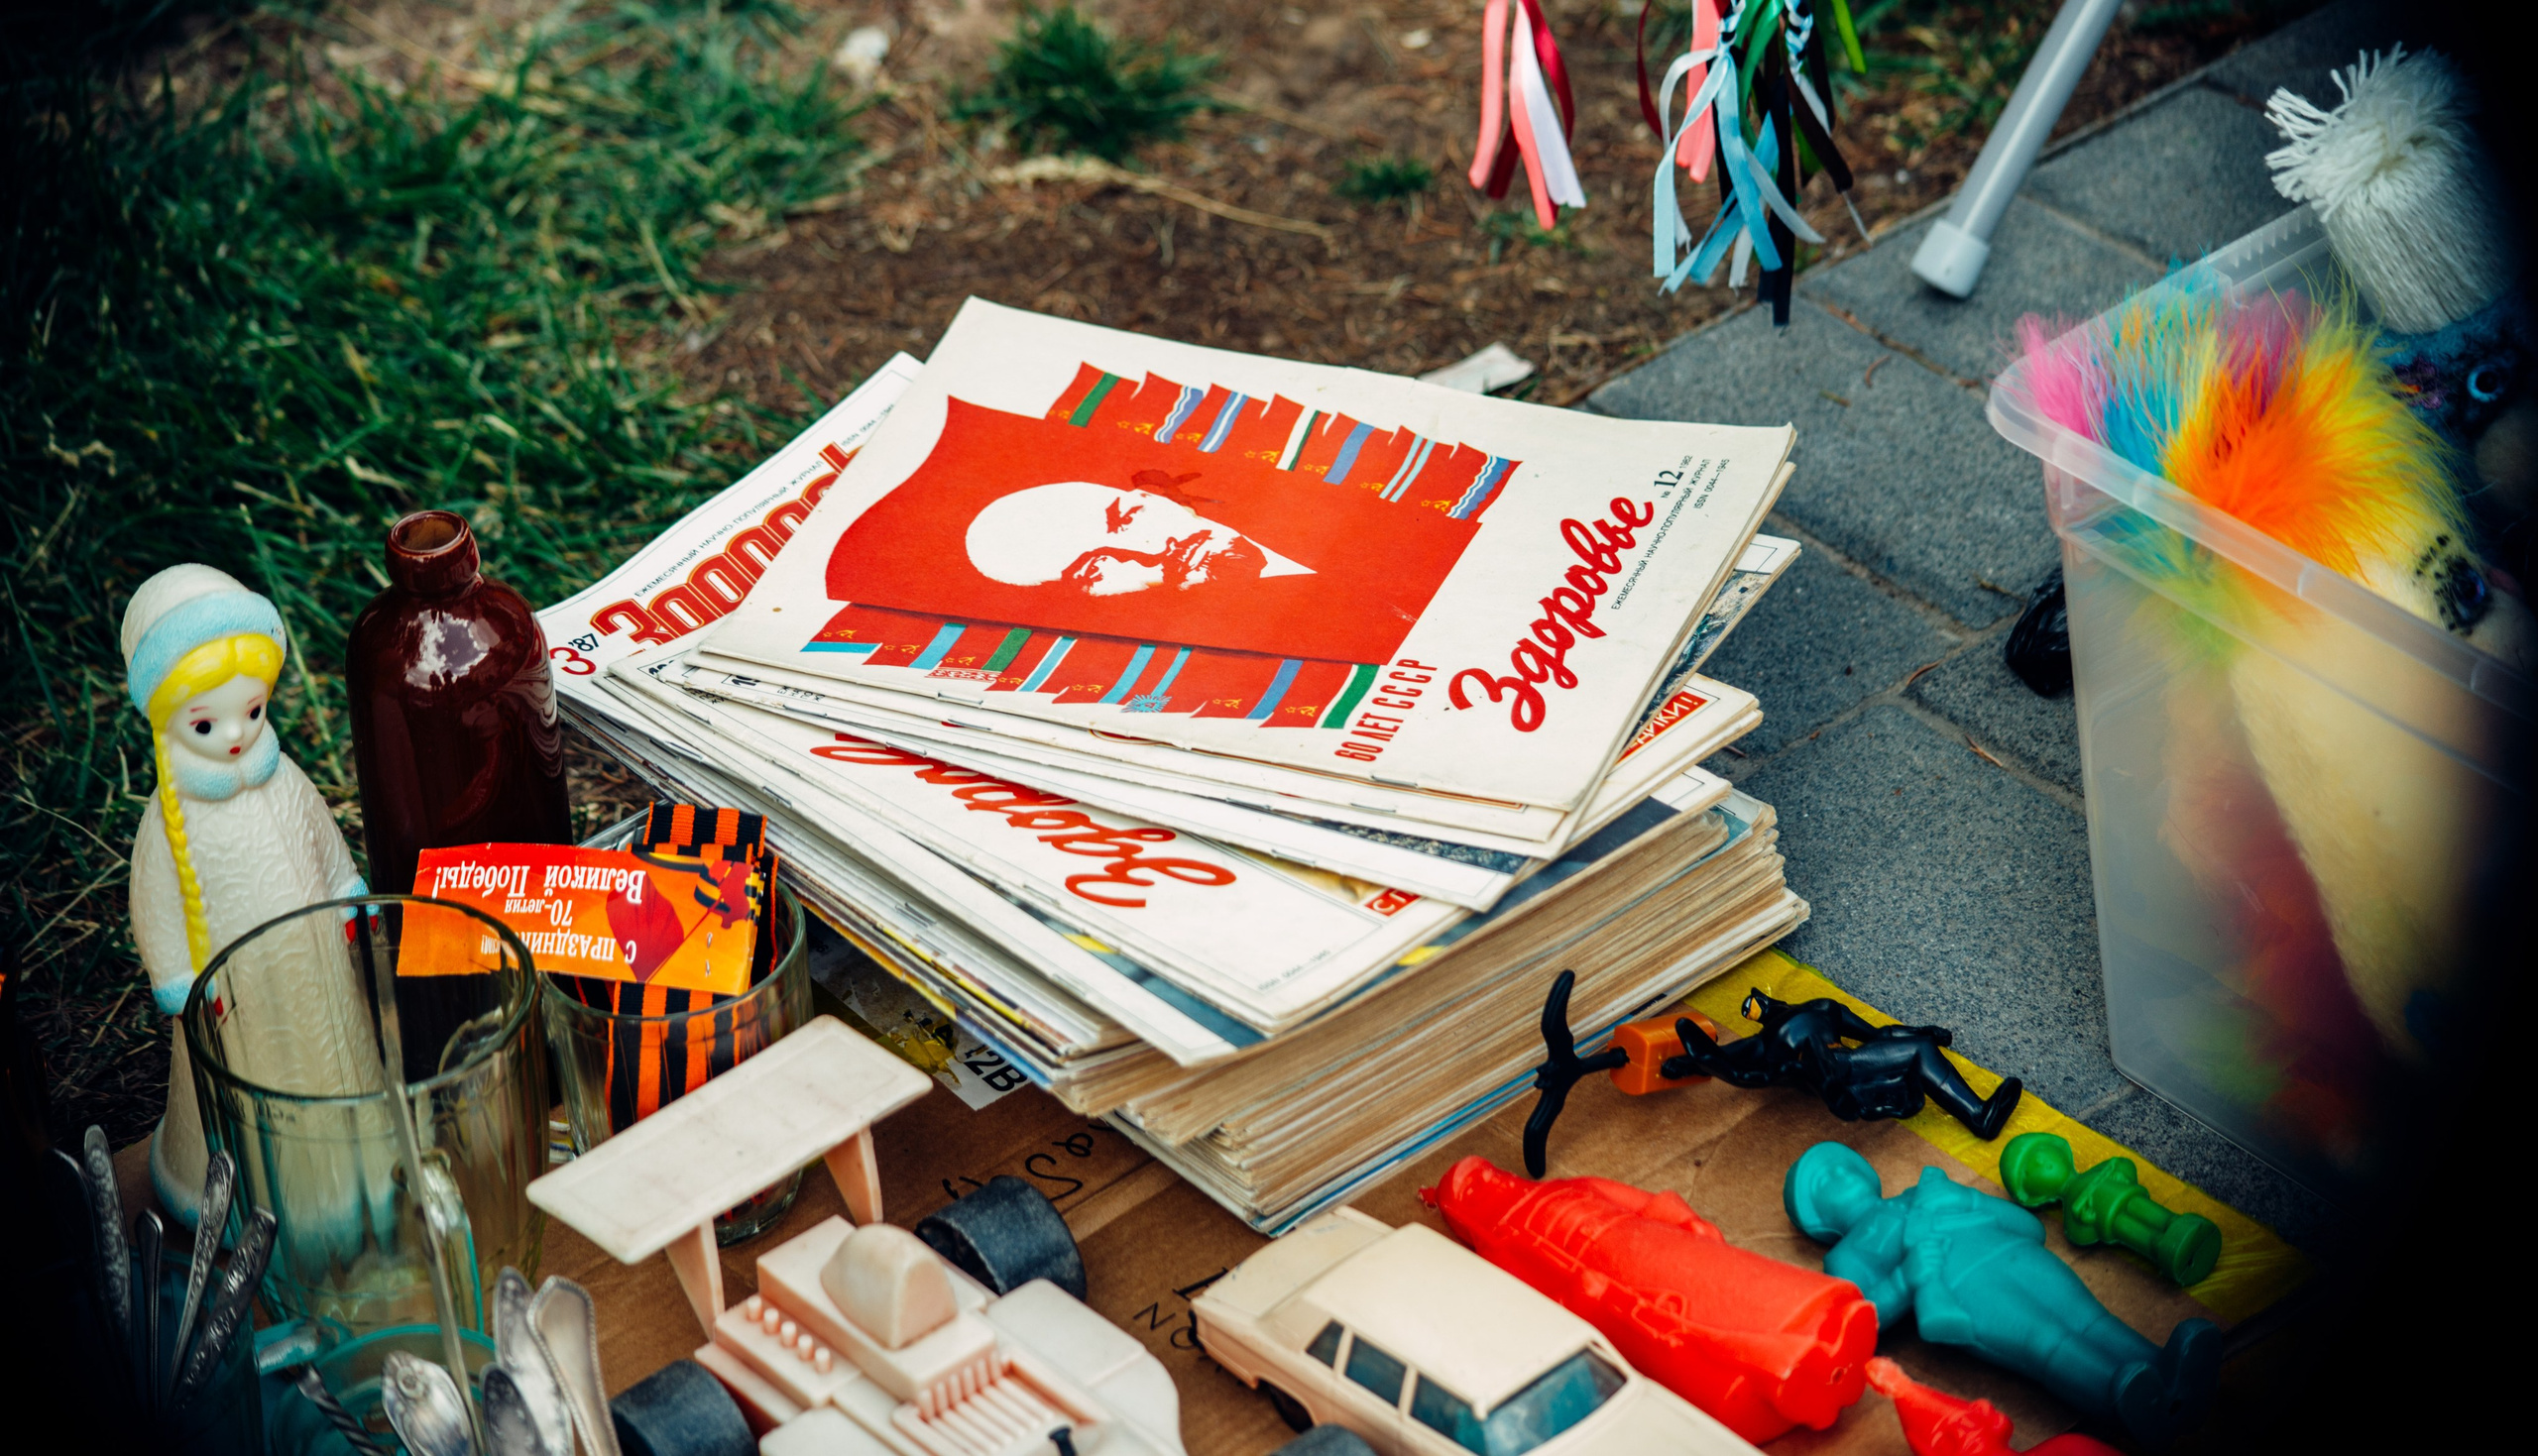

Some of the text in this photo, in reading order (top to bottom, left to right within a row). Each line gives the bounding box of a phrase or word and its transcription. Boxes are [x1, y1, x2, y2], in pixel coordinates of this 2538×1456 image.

[1654, 470, 1684, 489] 12
[1679, 454, 1693, 469] 1982
[1693, 494, 1709, 509] ISSN
[1611, 559, 1650, 611] ЕЖЕМЕСЯЧНЫЙ
[1689, 458, 1711, 487] ЖУРНАЛ
[1448, 497, 1655, 732] Здоровье
[1349, 712, 1404, 742] ЛЕТ
[1333, 741, 1384, 762] 60
[431, 860, 646, 904] Великой Победы!
[505, 899, 573, 927] 70-летия
[625, 940, 637, 963] С
